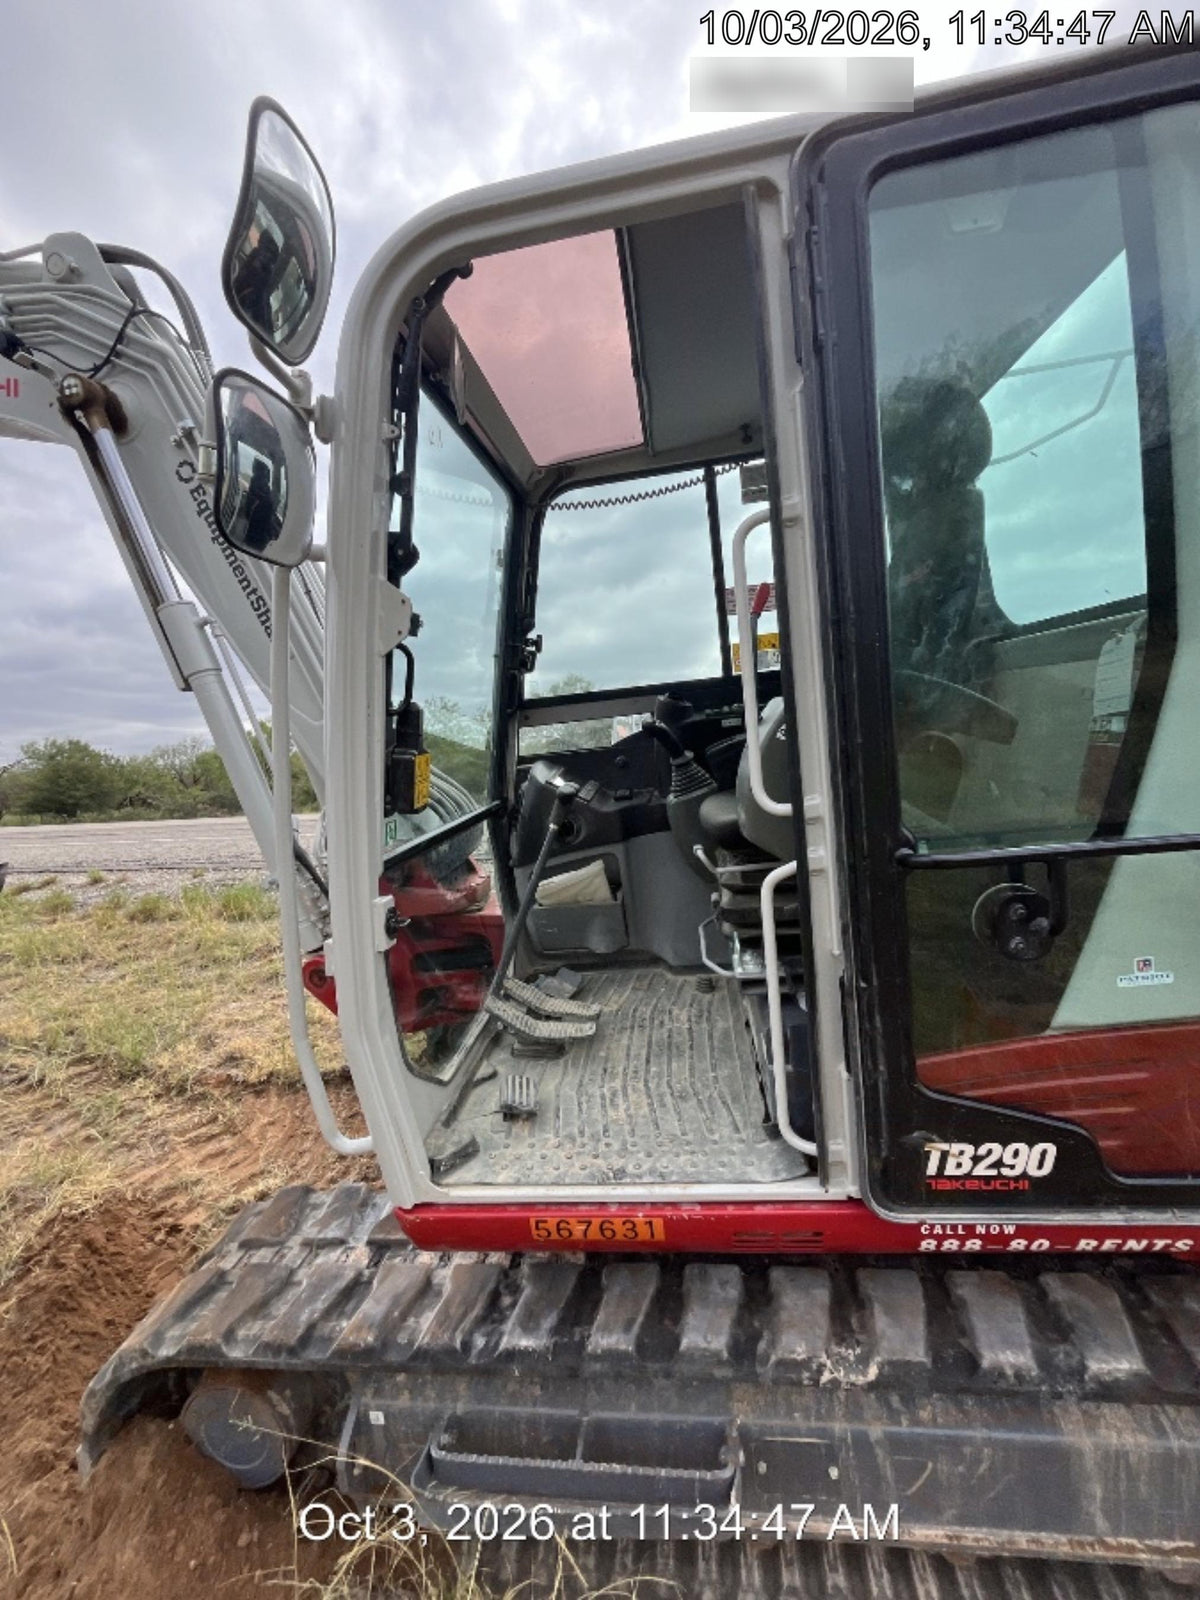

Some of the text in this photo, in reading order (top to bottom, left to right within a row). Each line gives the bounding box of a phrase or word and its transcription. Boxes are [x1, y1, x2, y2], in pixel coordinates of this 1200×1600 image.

[189, 484, 273, 642] EquipmentSha
[924, 1142, 1057, 1177] TB290
[534, 1219, 655, 1240] 567631
[920, 1224, 1016, 1234] CALL NOW
